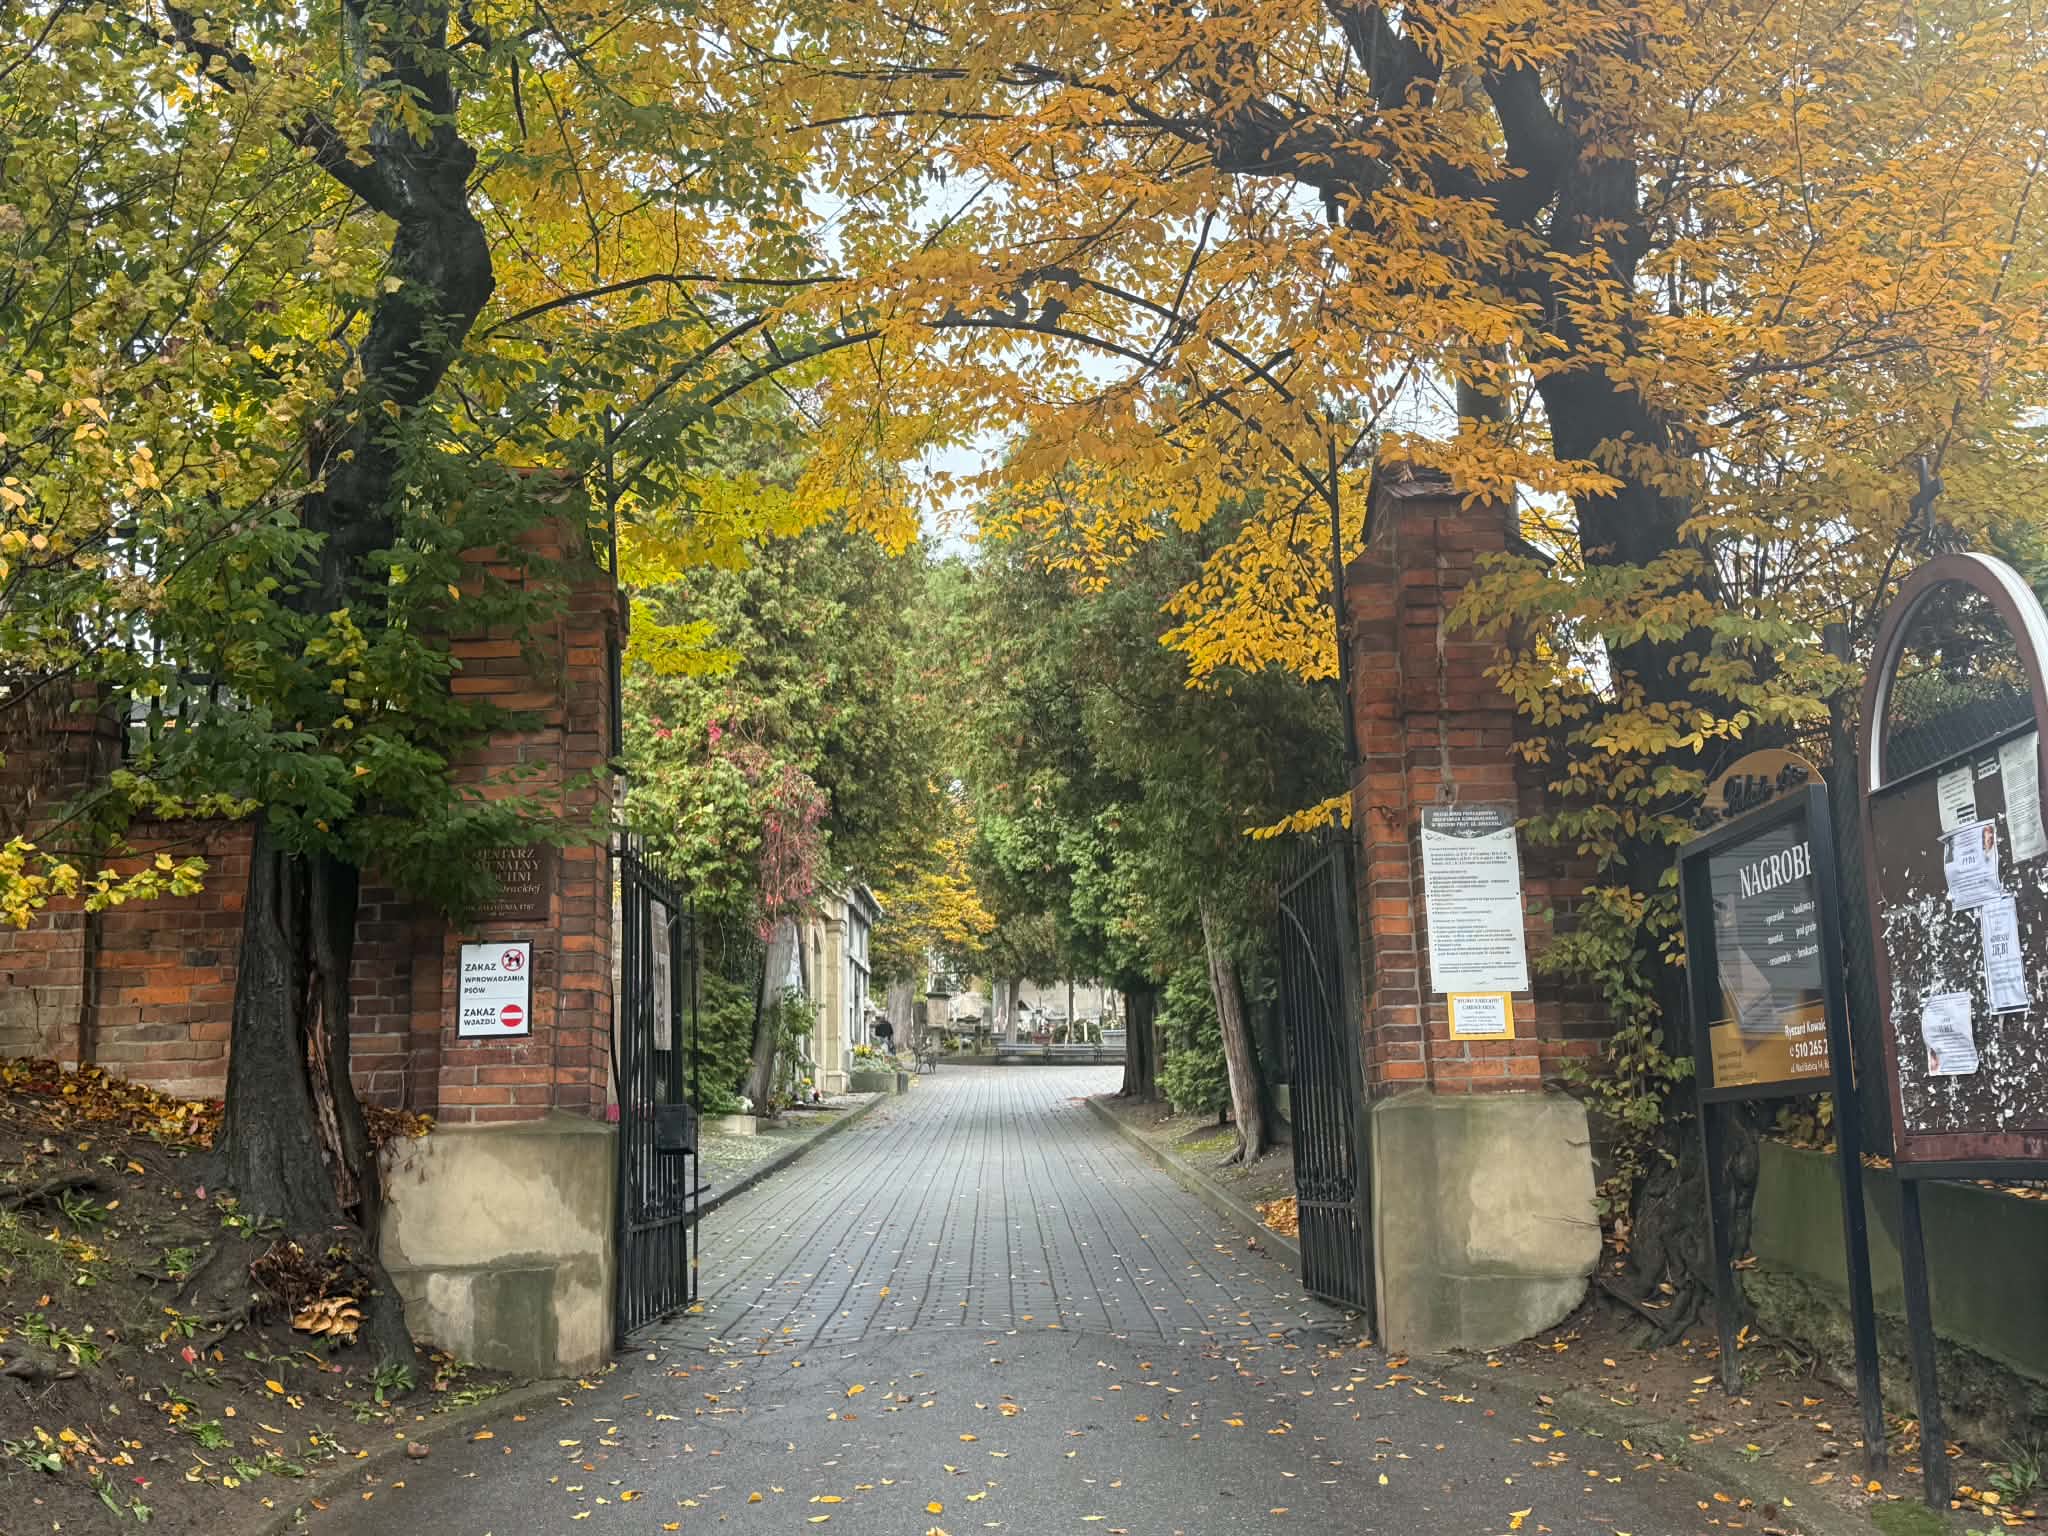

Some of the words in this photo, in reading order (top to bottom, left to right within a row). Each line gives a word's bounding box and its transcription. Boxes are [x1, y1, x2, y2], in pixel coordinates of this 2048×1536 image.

[464, 964, 497, 972] ZAKAZ
[464, 1008, 496, 1017] ZAKAZ
[464, 1018, 496, 1026] WJAZDU
[1795, 1042, 1808, 1059] 510
[1809, 1040, 1823, 1057] 265
